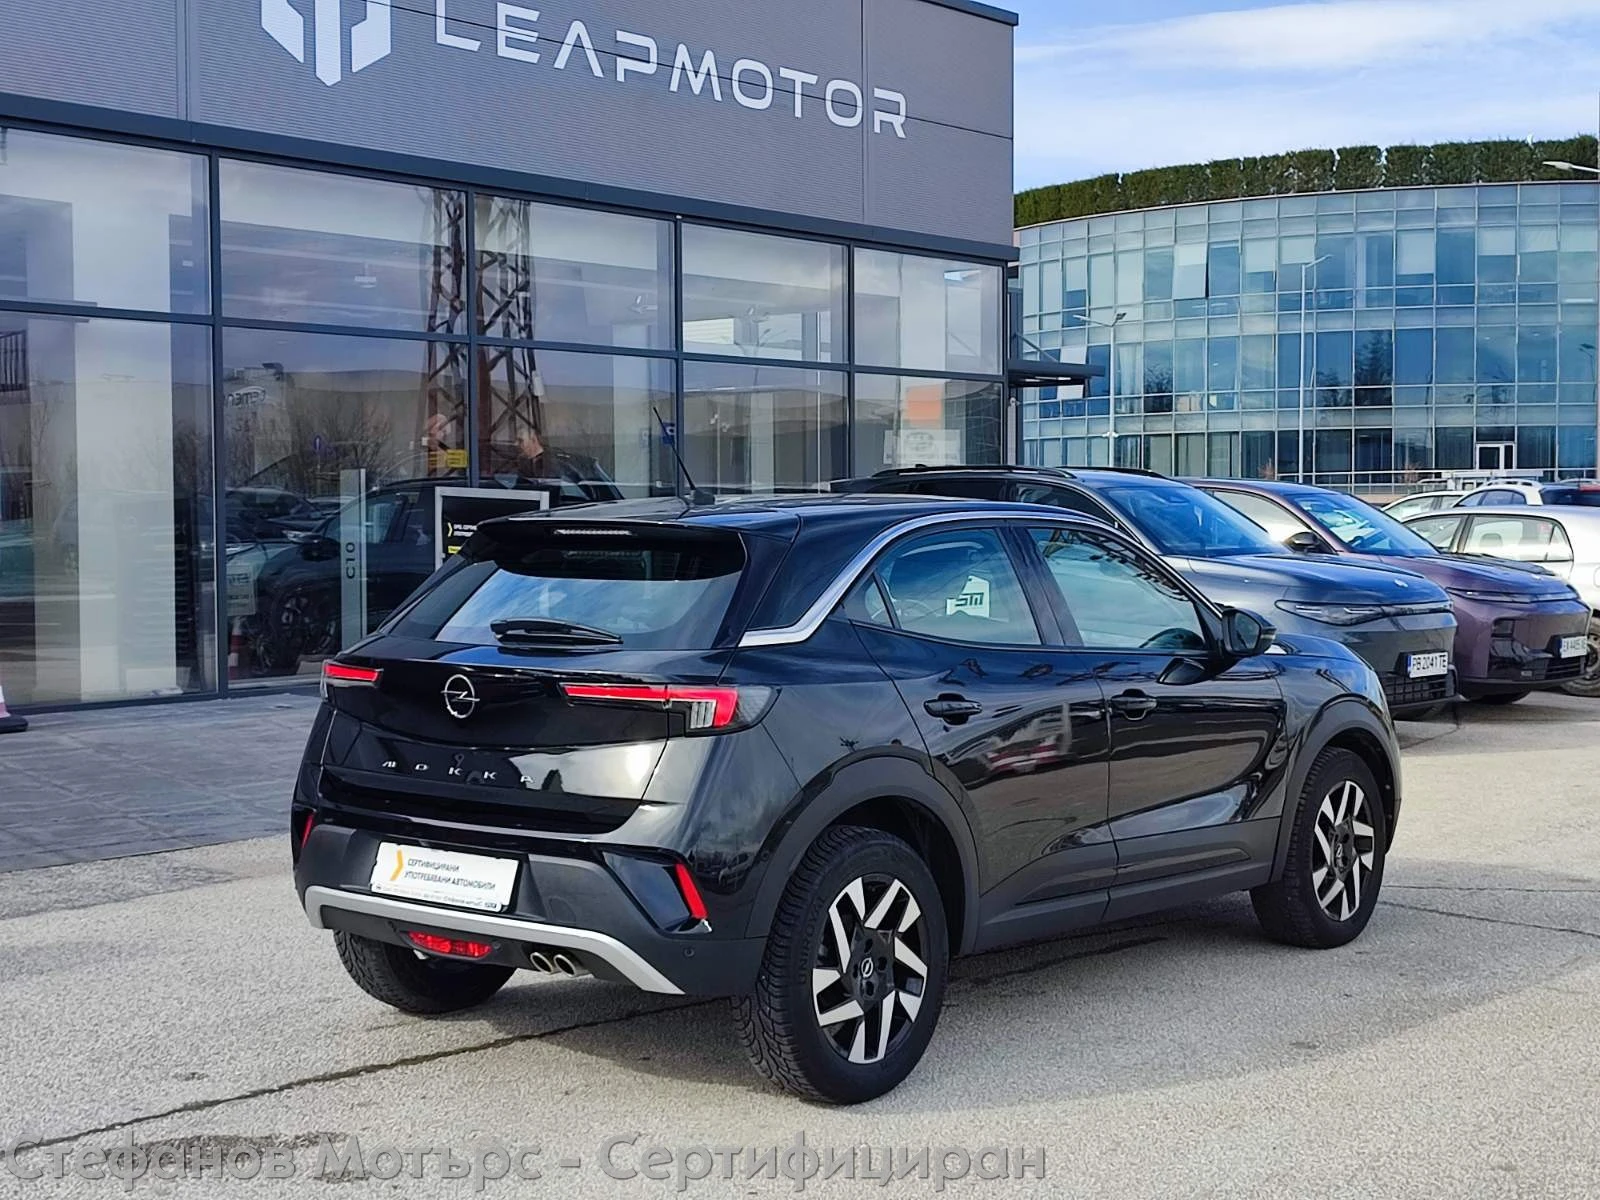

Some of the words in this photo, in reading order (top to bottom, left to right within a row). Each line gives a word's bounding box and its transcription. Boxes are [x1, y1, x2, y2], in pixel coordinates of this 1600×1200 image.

[436, 0, 907, 139] LEAPMOTOR
[345, 542, 356, 579] C10
[382, 760, 534, 783] MOKKA
